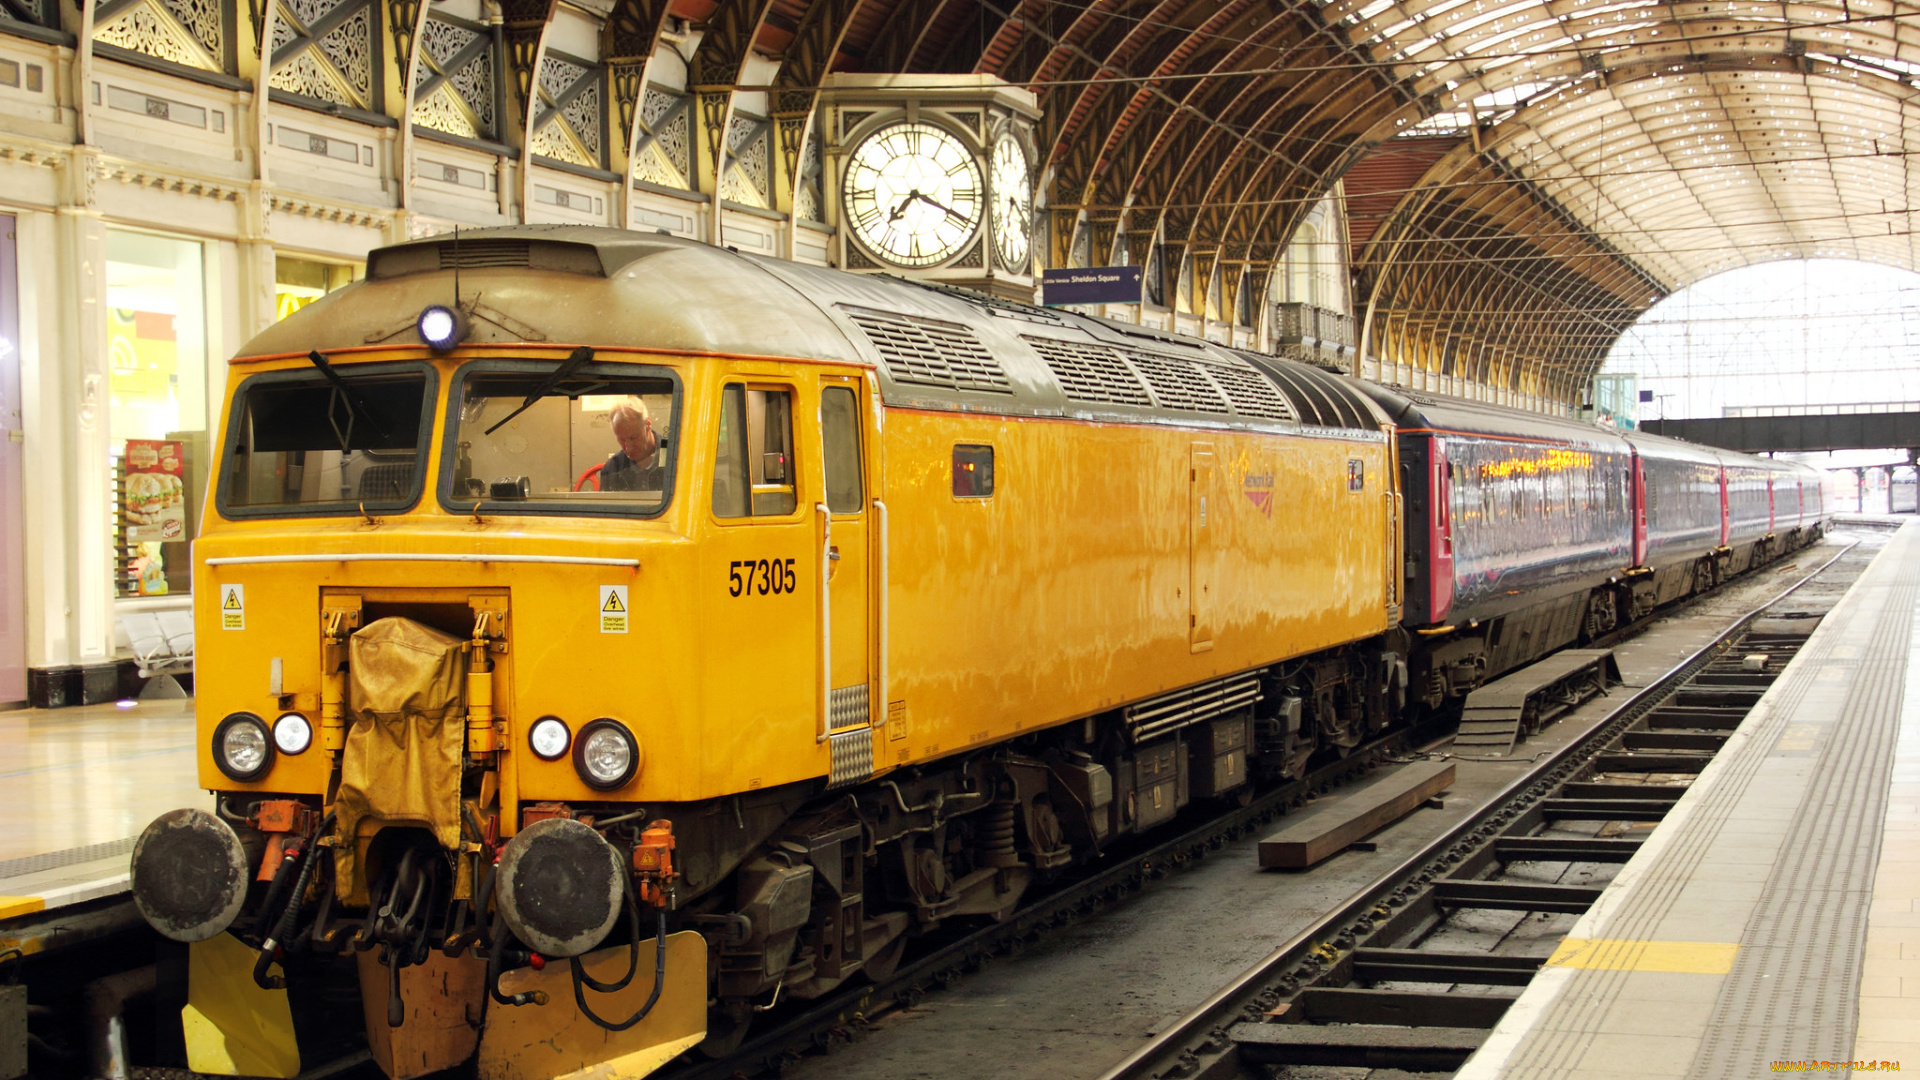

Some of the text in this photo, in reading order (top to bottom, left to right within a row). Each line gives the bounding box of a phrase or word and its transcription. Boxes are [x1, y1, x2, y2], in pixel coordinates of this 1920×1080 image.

[1071, 275, 1097, 283] Sheldon
[1098, 274, 1120, 283] Square
[729, 558, 796, 597] 57305
